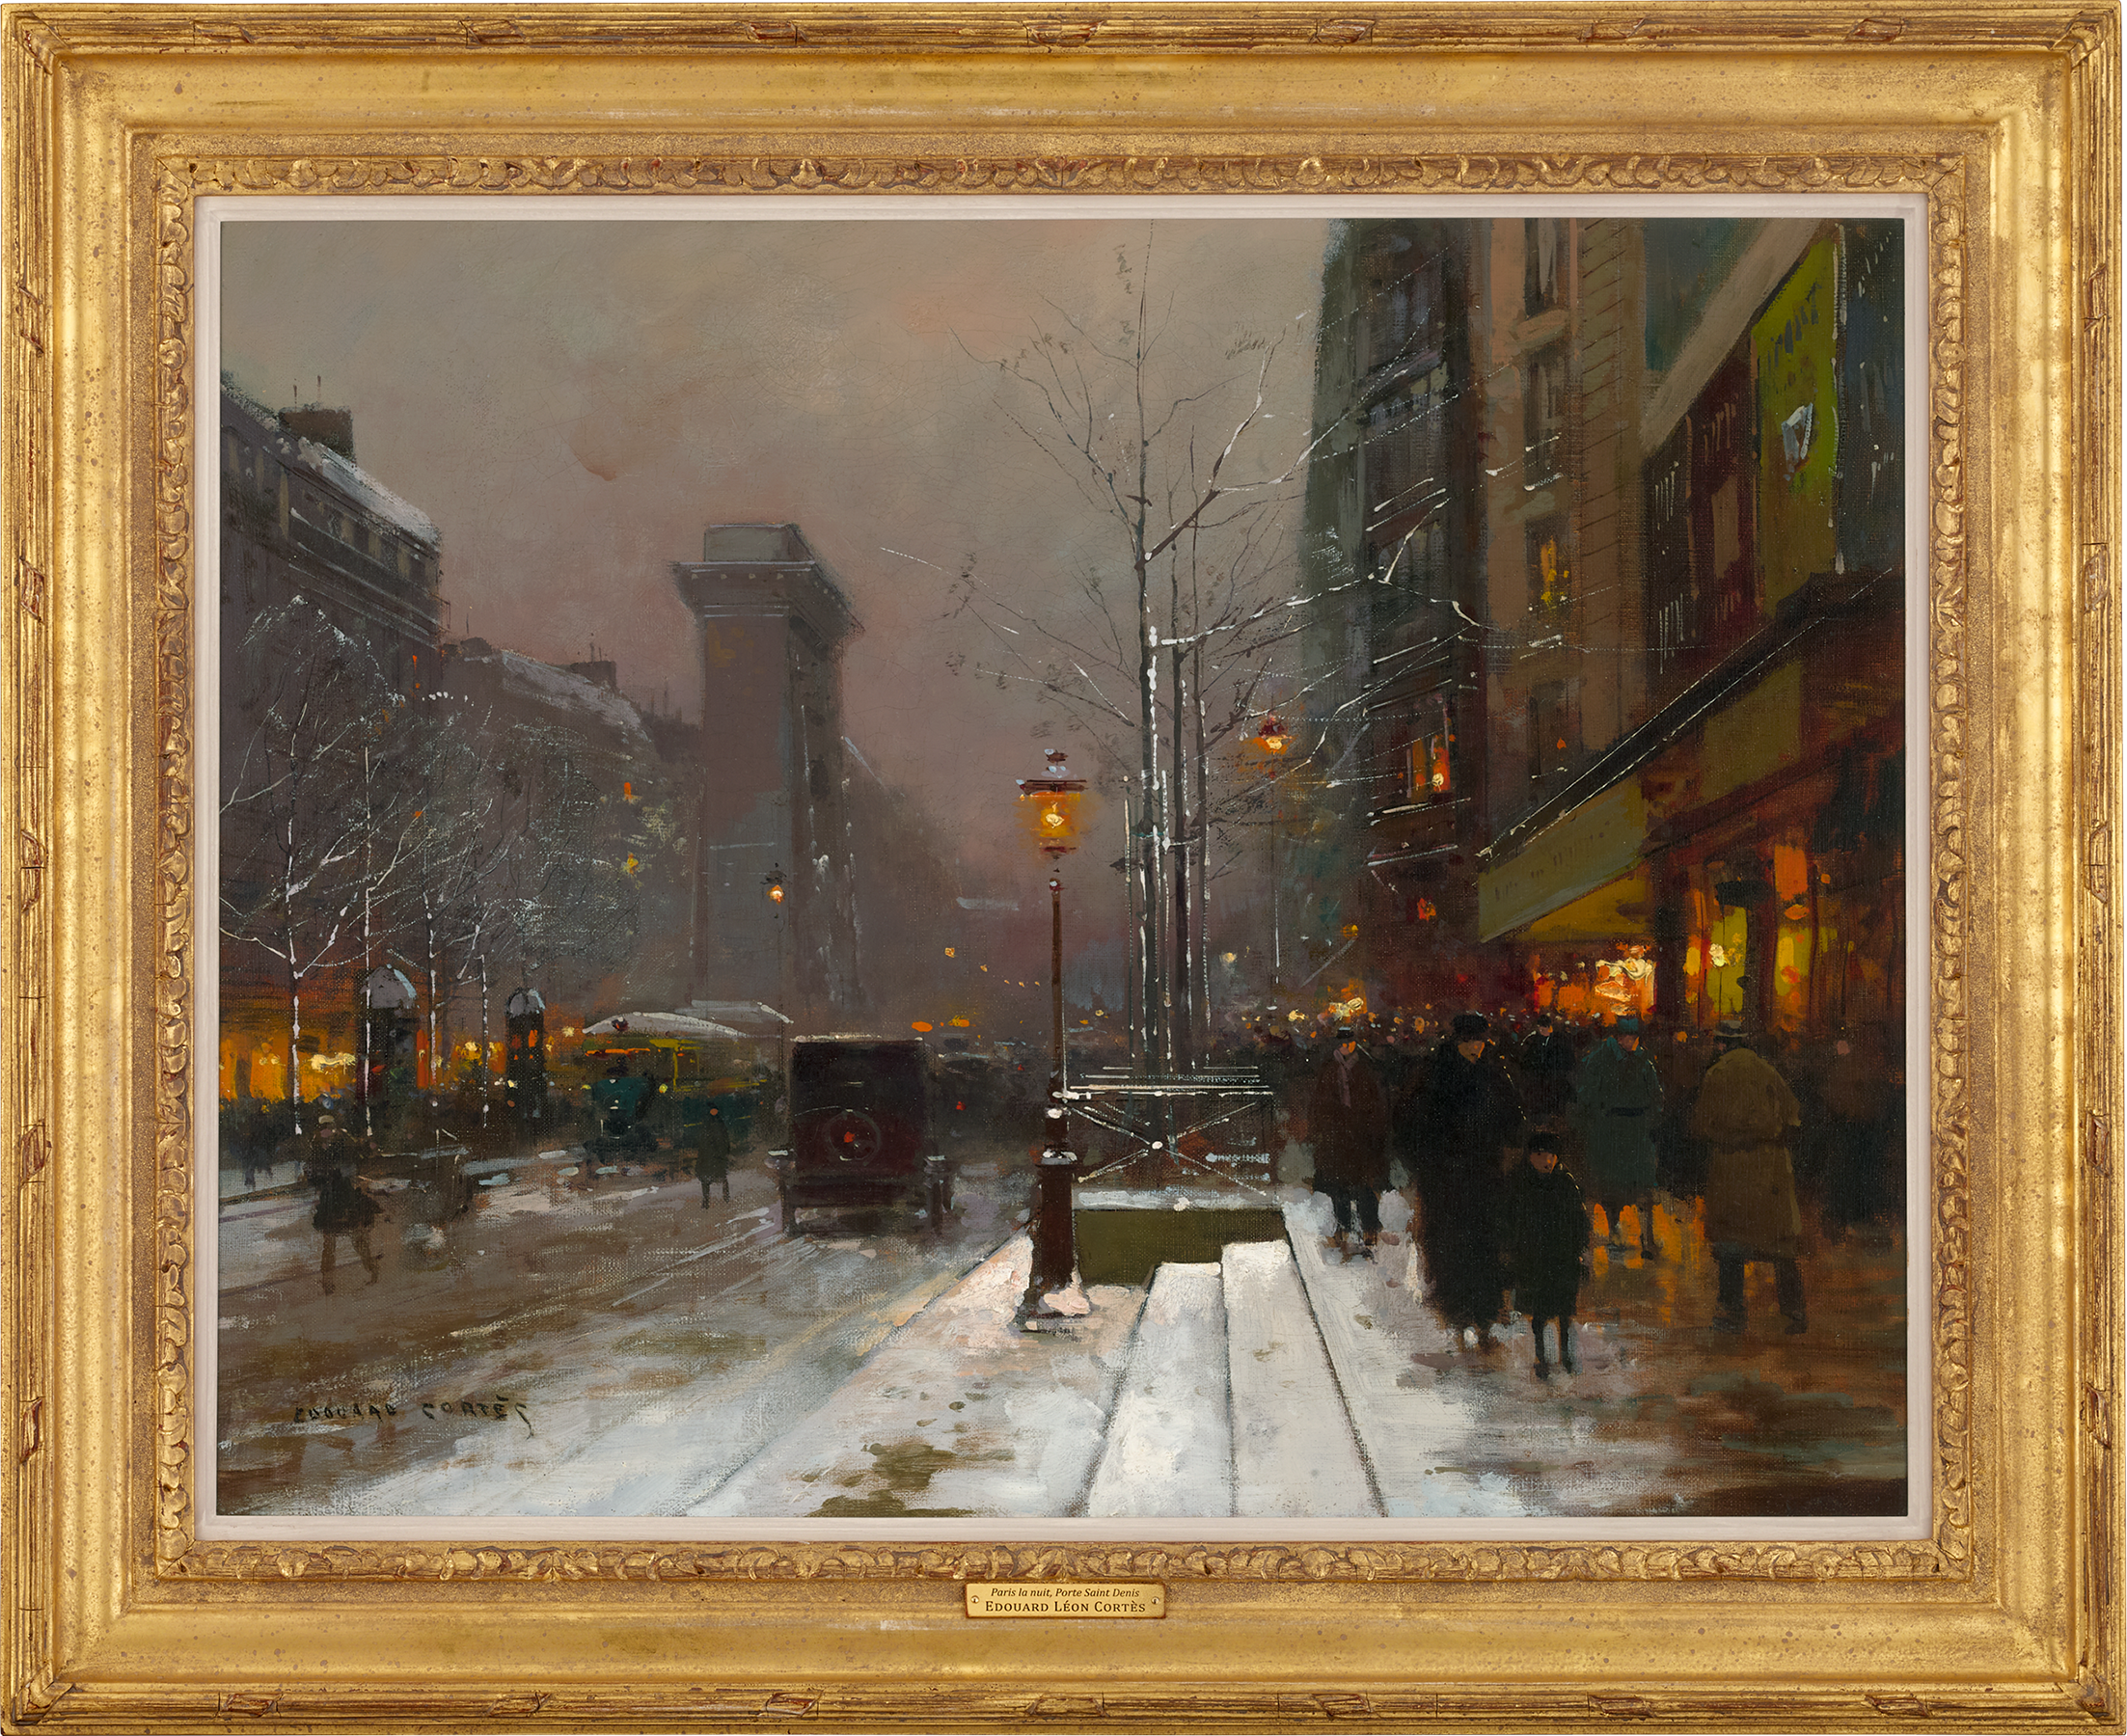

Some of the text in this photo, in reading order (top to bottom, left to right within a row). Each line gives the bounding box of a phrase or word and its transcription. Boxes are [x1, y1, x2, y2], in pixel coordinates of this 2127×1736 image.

[991, 1587, 1139, 1598] Paris la nuit, Porte Saint Denis
[985, 1599, 1146, 1612] EDOUARD LÉON CORTÈS
